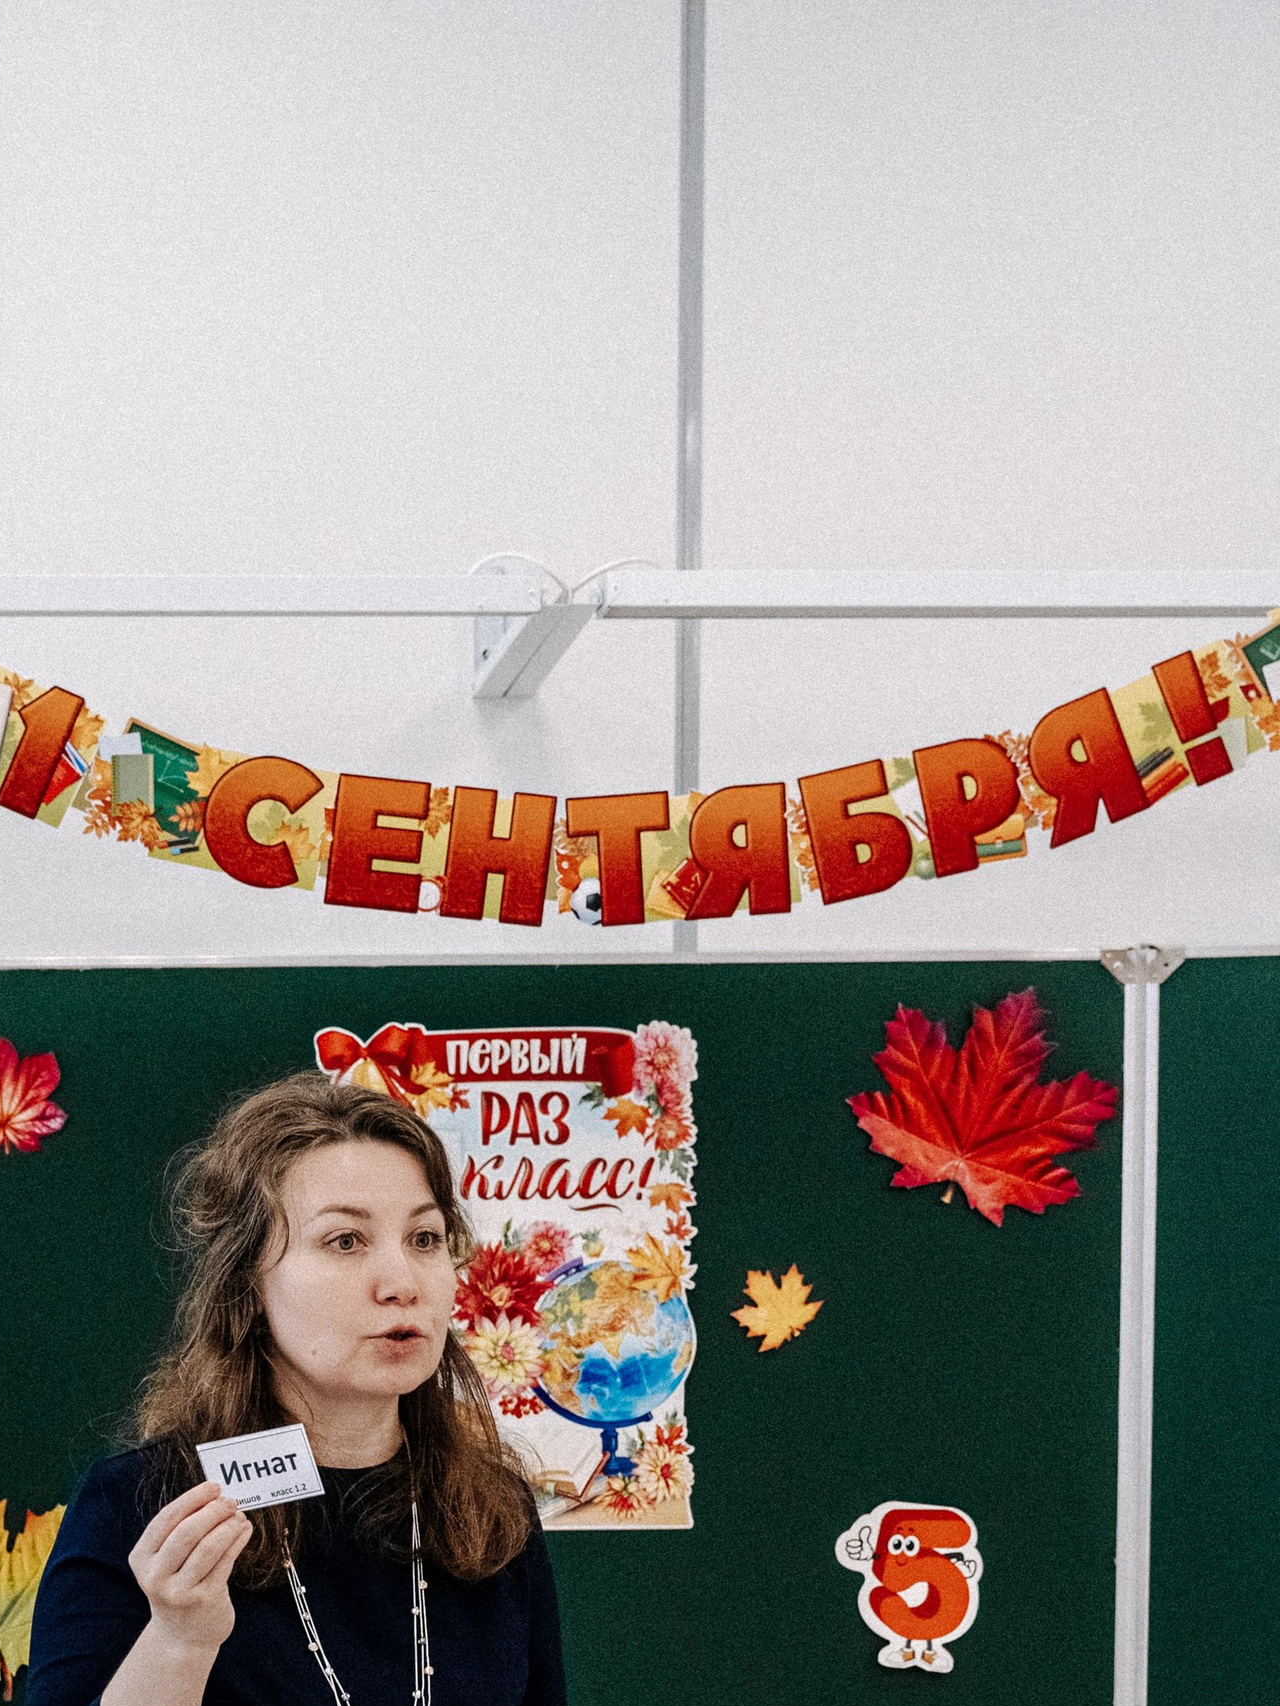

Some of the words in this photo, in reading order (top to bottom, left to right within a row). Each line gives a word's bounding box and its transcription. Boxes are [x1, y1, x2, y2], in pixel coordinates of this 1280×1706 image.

[203, 650, 1233, 927] СЕНТЯБРЯ!
[481, 1090, 571, 1147] РАЗ
[220, 1453, 297, 1485] Игнат
[270, 1487, 294, 1498] класс
[294, 1483, 308, 1493] 1.2
